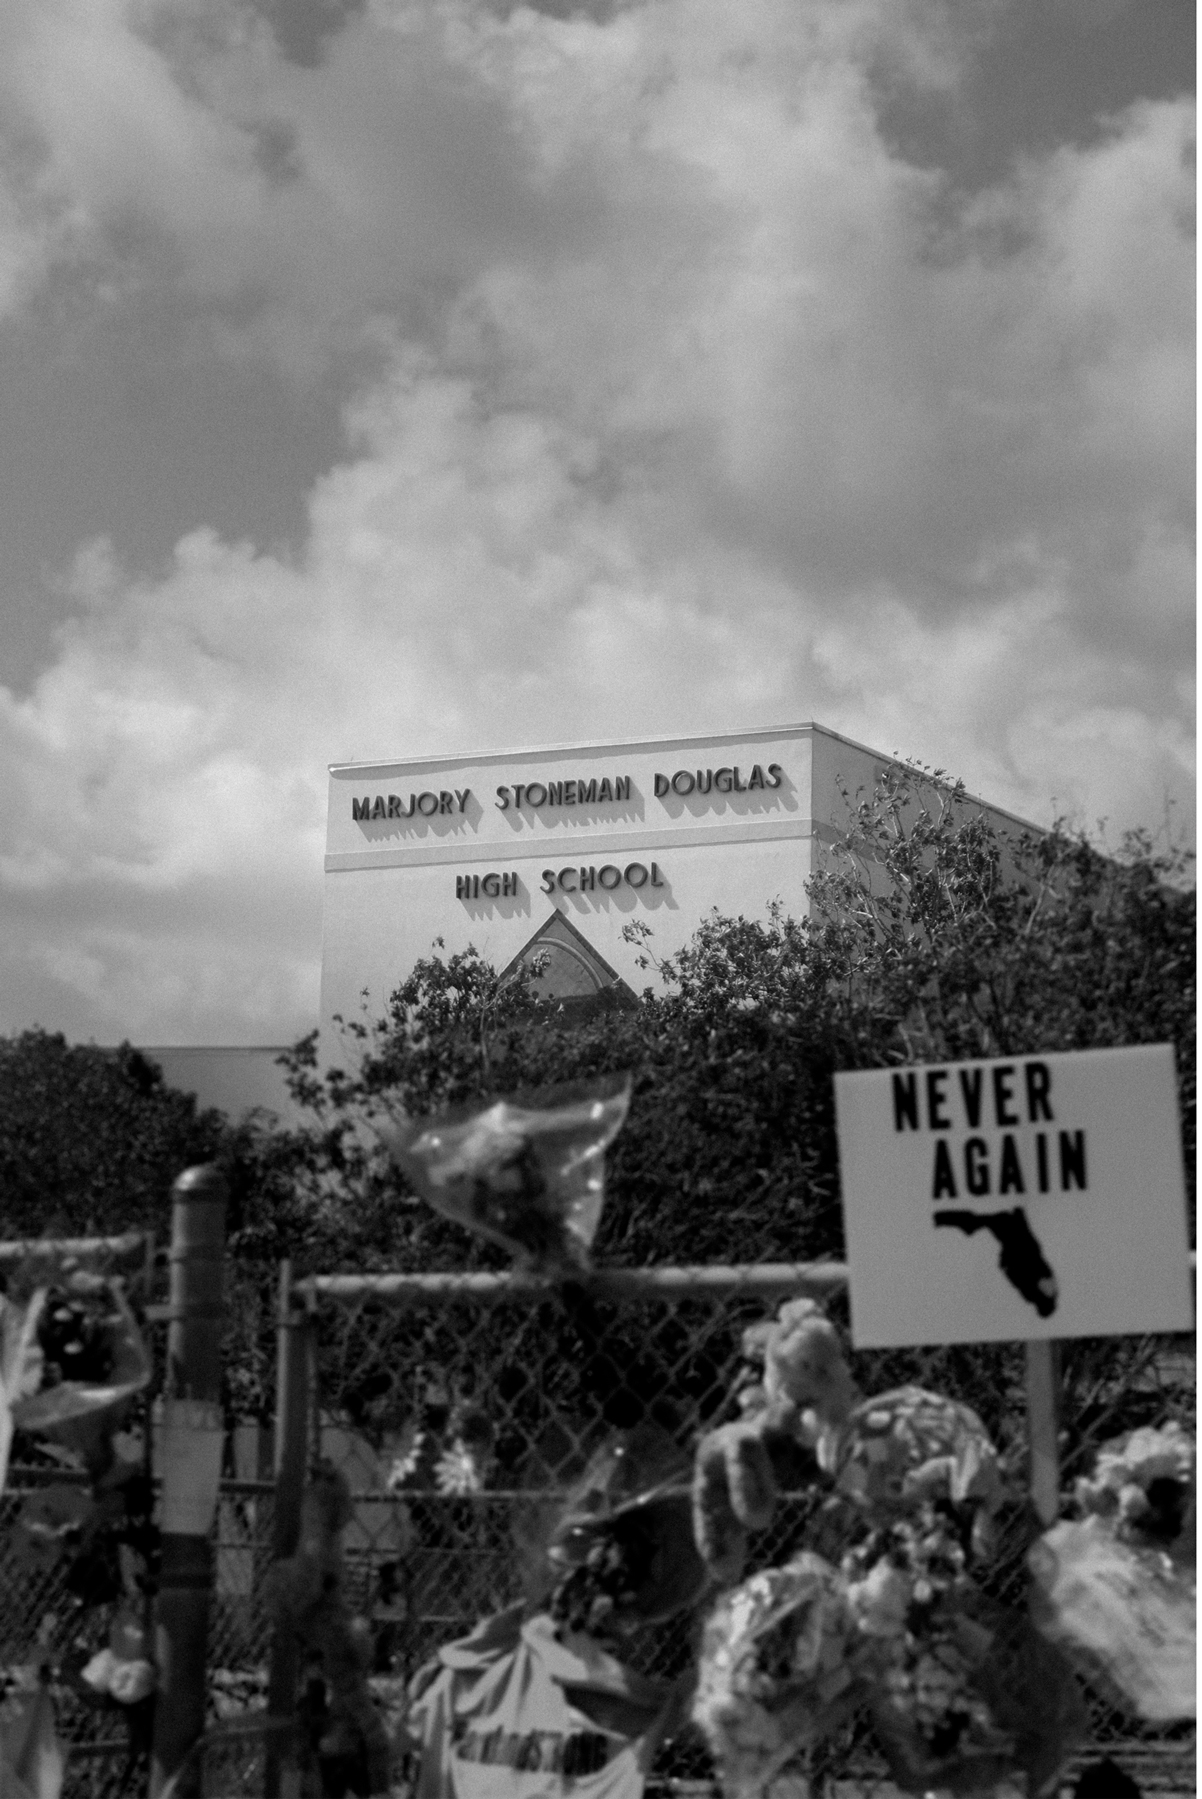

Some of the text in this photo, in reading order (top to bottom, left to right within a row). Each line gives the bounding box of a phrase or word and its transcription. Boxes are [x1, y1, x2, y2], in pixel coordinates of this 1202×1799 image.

[352, 763, 783, 821] MARJORY STONEMAN DOUGLAS
[455, 861, 665, 900] HIGH SCHOOL
[892, 1061, 1054, 1133] NEVER
[932, 1129, 1087, 1200] AGAIN
